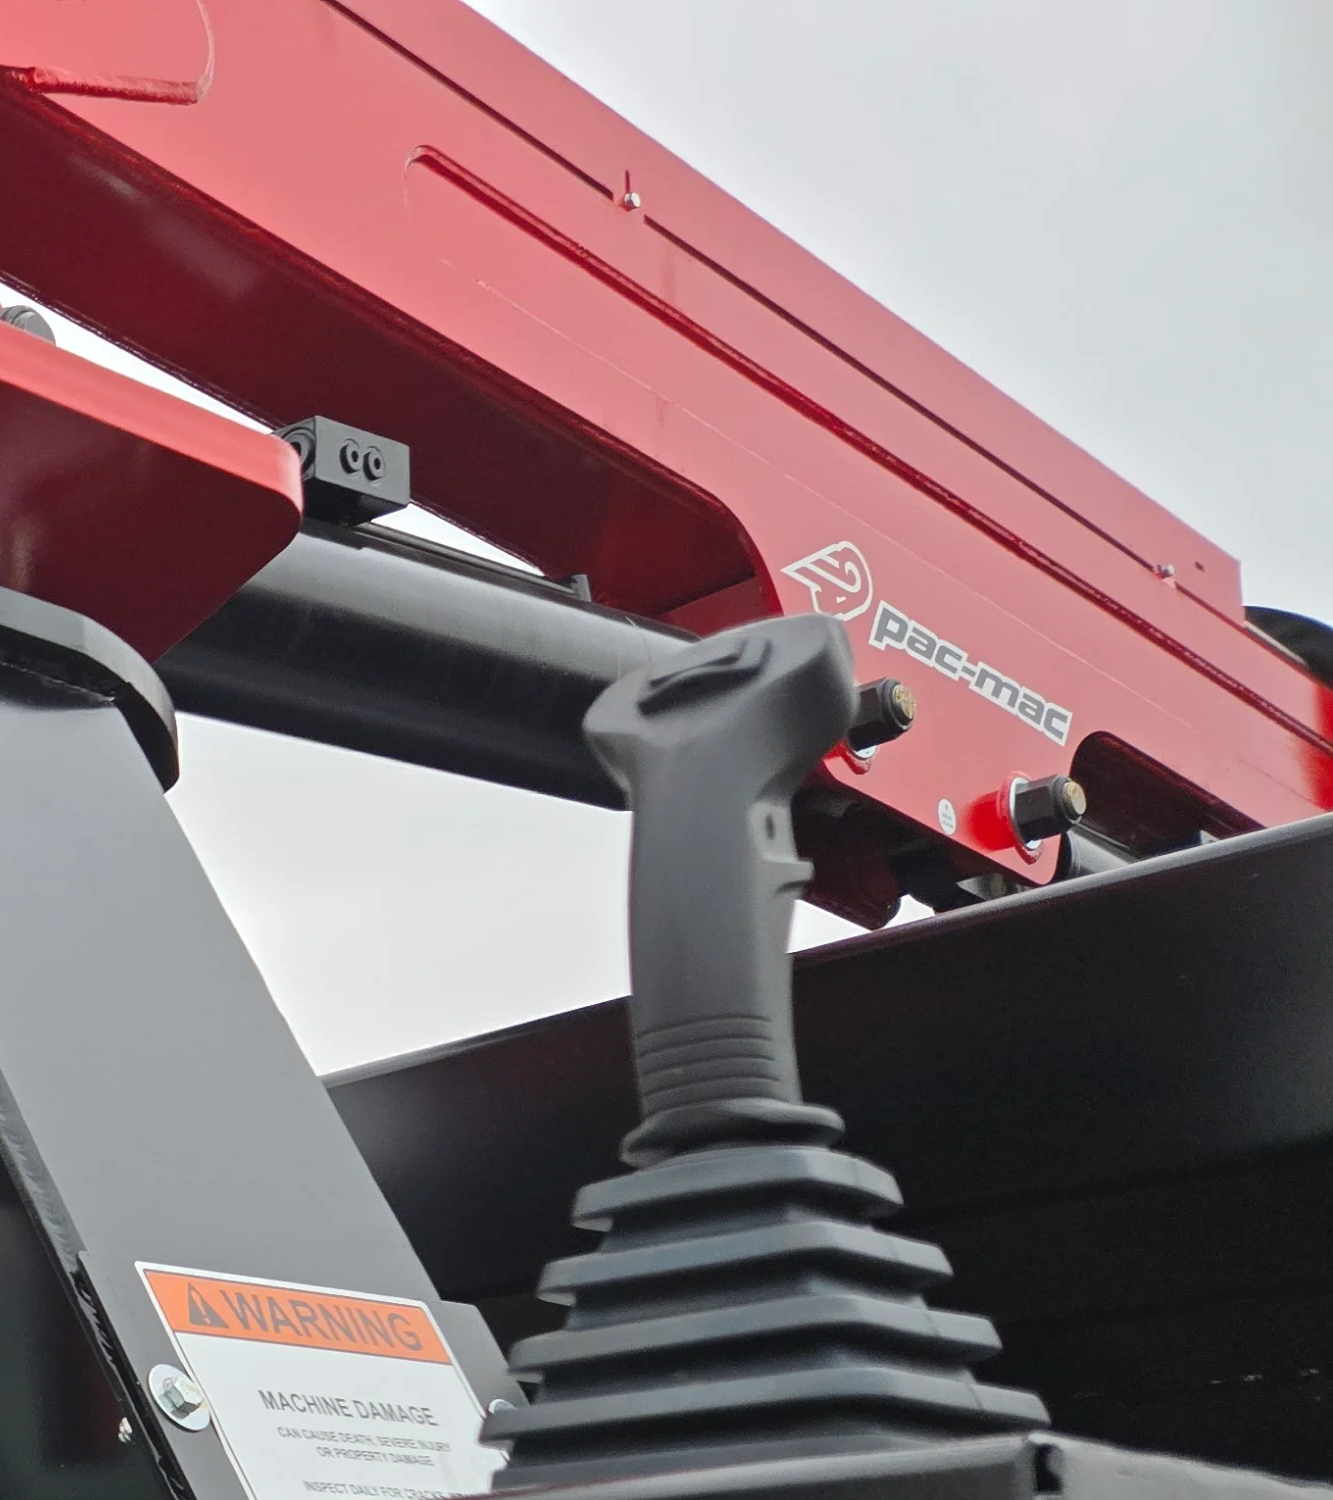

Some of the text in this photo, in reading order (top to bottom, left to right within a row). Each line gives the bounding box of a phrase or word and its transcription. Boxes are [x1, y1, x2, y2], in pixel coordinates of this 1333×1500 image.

[869, 602, 1072, 746] pac-mac
[221, 1289, 423, 1351] WARNING
[258, 1389, 439, 1426] MACHINE DAMAGE
[277, 1426, 303, 1440] CAN
[305, 1429, 337, 1443] CAUSE
[377, 1436, 417, 1449] SEVERE
[316, 1447, 329, 1457] OR
[335, 1449, 388, 1463] PROPERTY
[303, 1481, 347, 1495] INSPECT
[349, 1483, 378, 1496] DAILY
[380, 1486, 402, 1498] FOR
